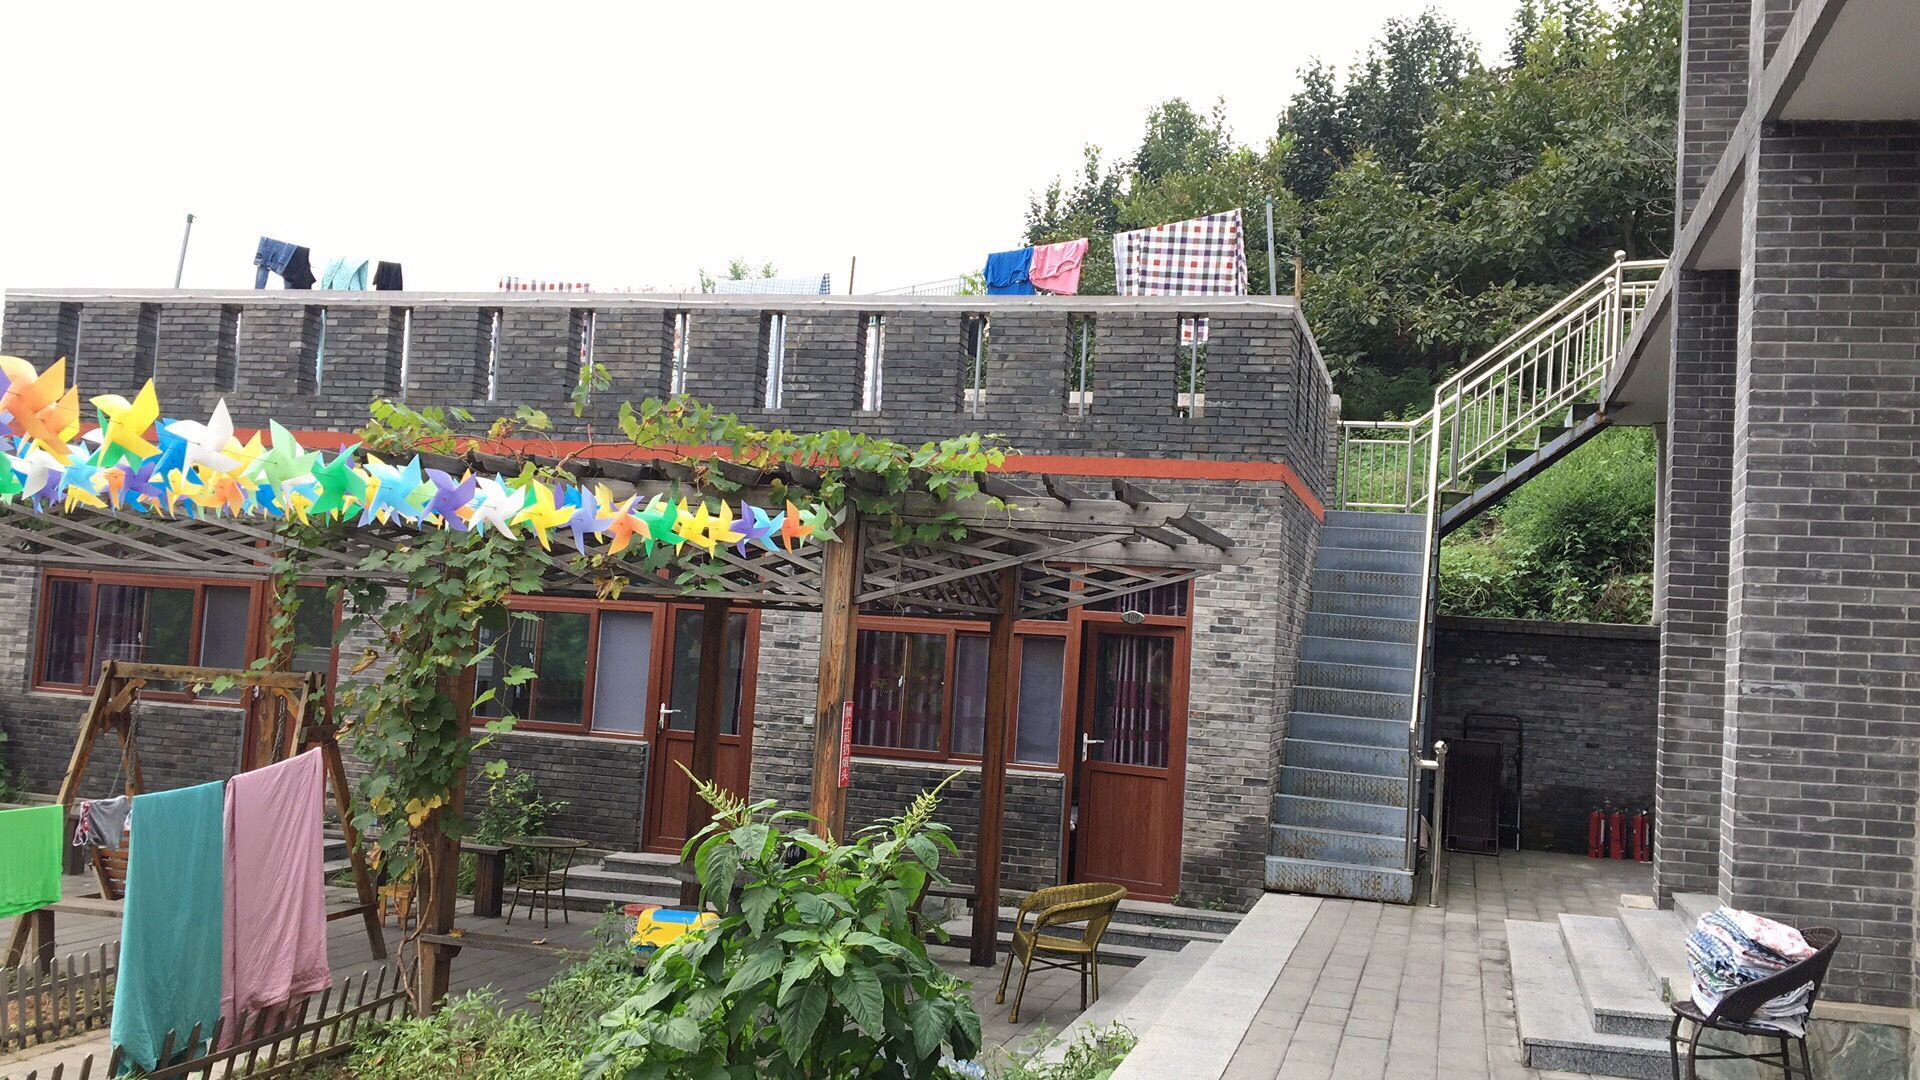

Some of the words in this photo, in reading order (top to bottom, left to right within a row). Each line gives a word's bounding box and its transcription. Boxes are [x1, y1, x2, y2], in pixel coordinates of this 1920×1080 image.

[841, 705, 852, 782] 禁止乱扔烟头
